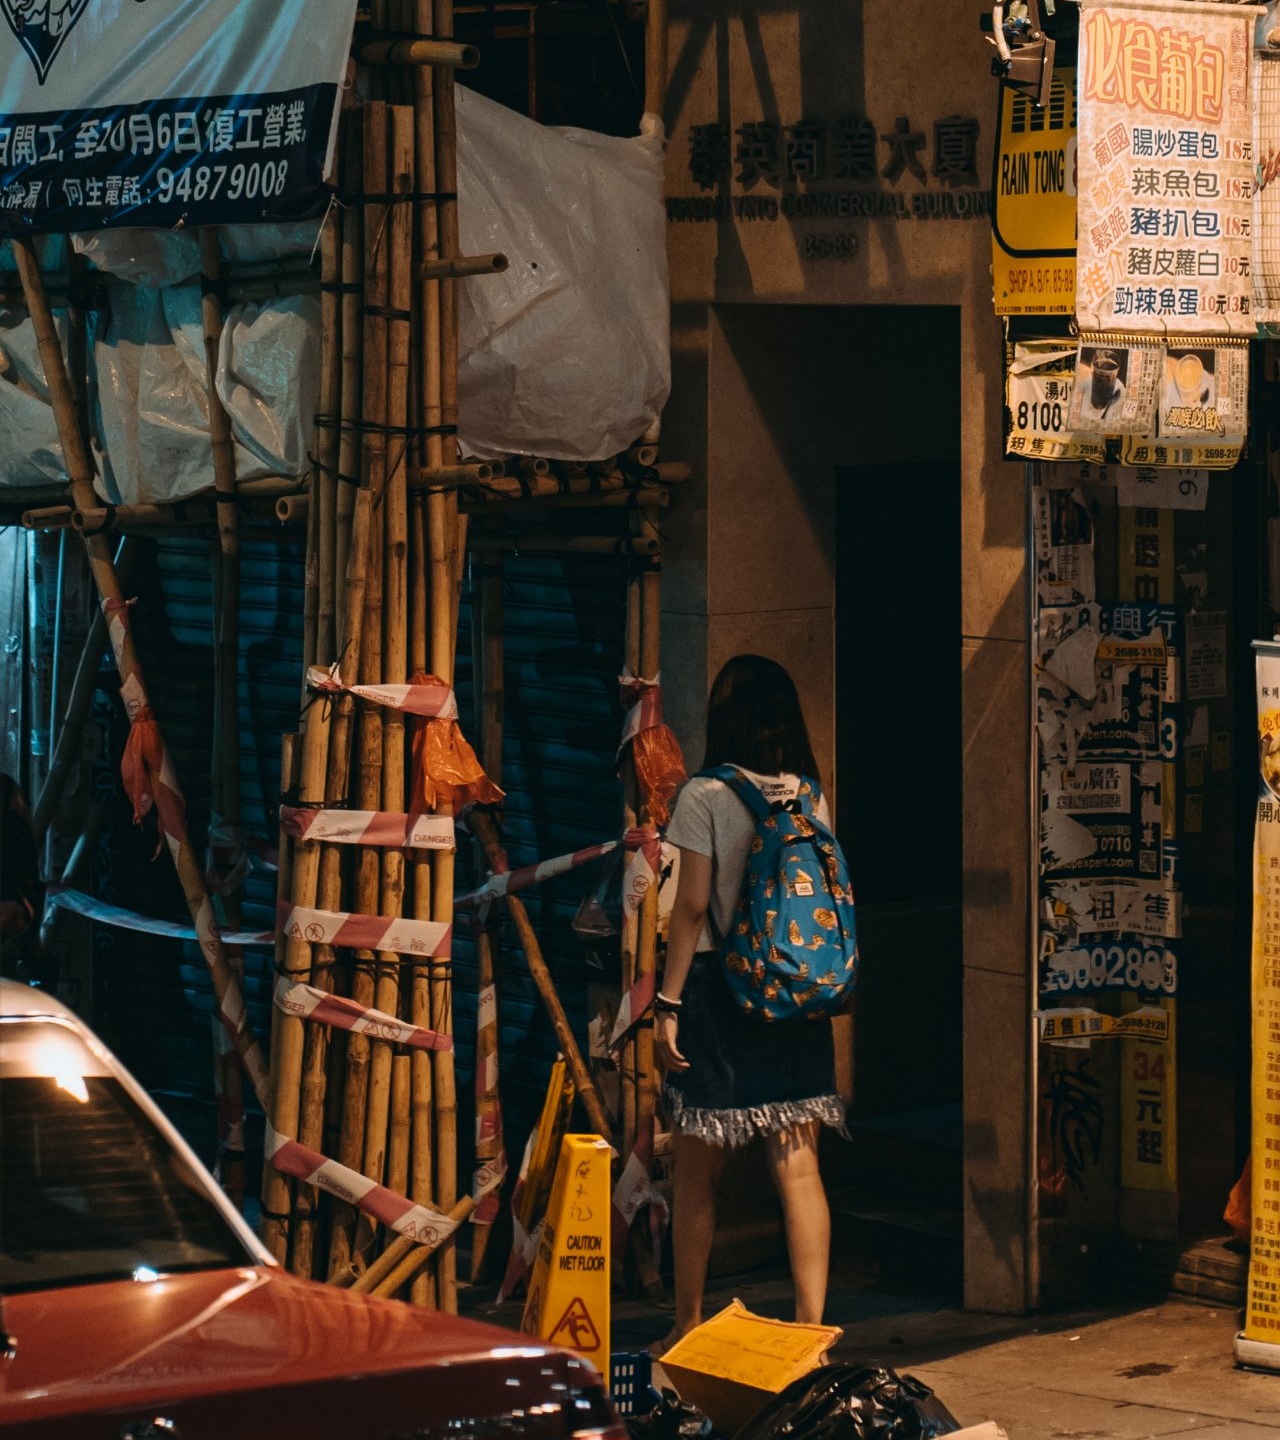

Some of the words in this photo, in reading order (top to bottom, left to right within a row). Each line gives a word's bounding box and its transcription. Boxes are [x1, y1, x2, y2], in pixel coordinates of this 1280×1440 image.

[1084, 8, 1226, 123] 必食葡包
[689, 114, 981, 192] 群英商業大廈
[1131, 128, 1220, 160] 腸炒蛋包
[1224, 138, 1252, 163] 18元
[1001, 150, 1031, 197] RAIN
[1033, 148, 1067, 193] TONG
[1131, 167, 1221, 201] 辣魚包
[1224, 180, 1252, 202] 18元
[781, 190, 908, 222] COMMERCIAL
[1129, 207, 1221, 239] 豬扒包
[1224, 216, 1251, 238] 18元
[1127, 248, 1221, 279] 豬皮蘿白
[1223, 255, 1250, 277] 10元
[1009, 269, 1028, 294] SHOP
[1113, 286, 1199, 317] 勁辣魚蛋
[1016, 400, 1063, 433] 8100
[763, 788, 795, 797] balance
[412, 831, 456, 846] DANGER
[566, 1234, 602, 1251] CAUTION
[559, 1255, 579, 1272] WET
[578, 1255, 606, 1272] FLOOR
